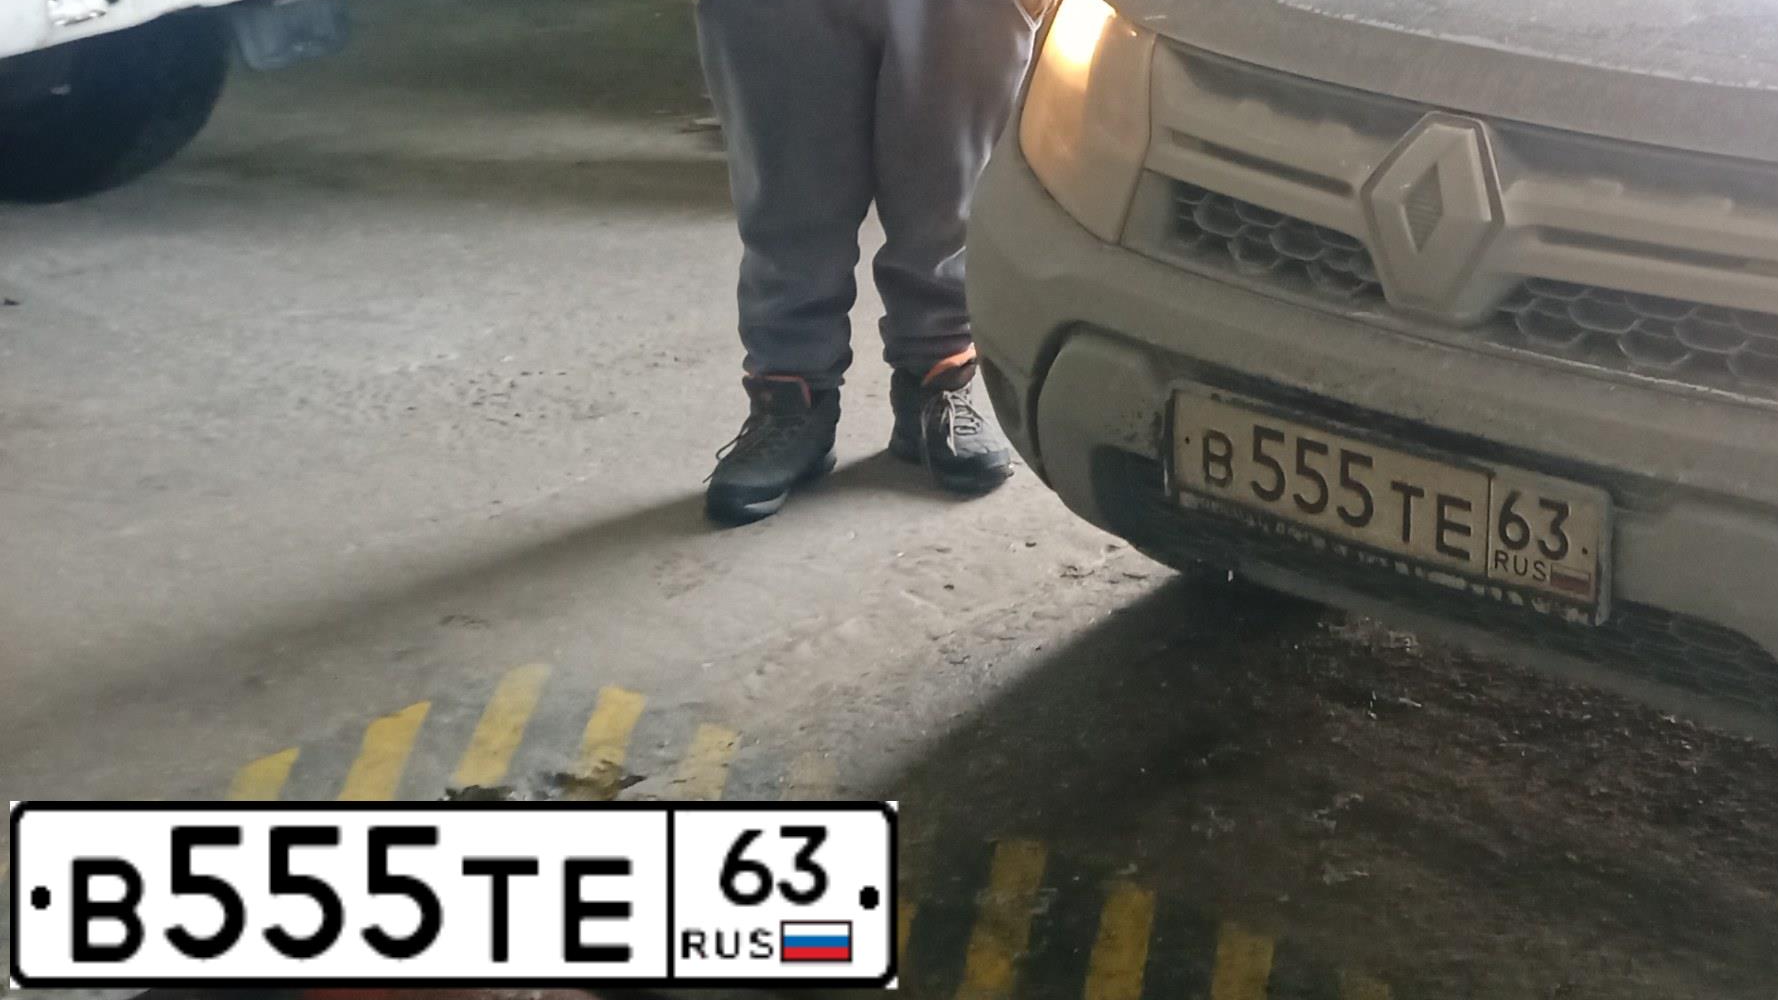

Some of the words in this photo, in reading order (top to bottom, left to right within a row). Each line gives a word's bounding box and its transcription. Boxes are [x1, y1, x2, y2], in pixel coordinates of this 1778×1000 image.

[1202, 425, 1472, 562] B555TE
[1500, 489, 1571, 561] 63
[1495, 550, 1548, 583] RUS
